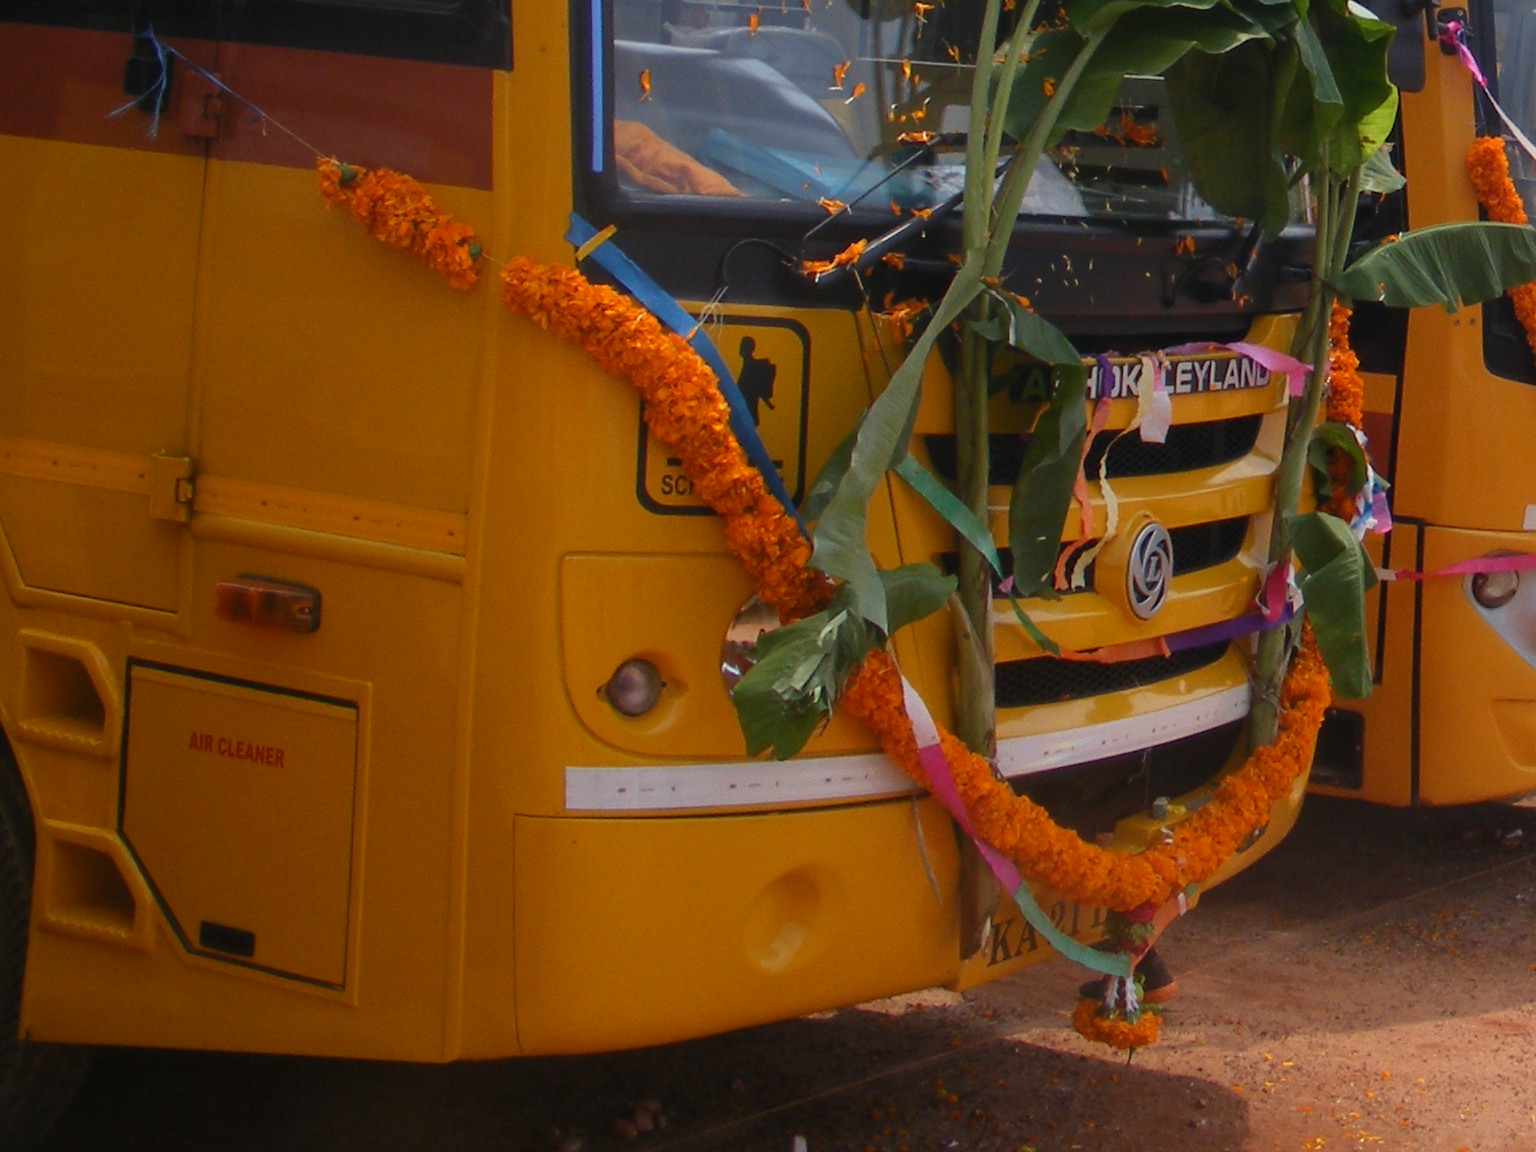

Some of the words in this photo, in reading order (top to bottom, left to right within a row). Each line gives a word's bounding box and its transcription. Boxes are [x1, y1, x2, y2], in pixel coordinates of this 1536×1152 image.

[1161, 356, 1270, 395] LEYLAND
[189, 732, 213, 754] AIR
[218, 737, 284, 768] CLEANER
